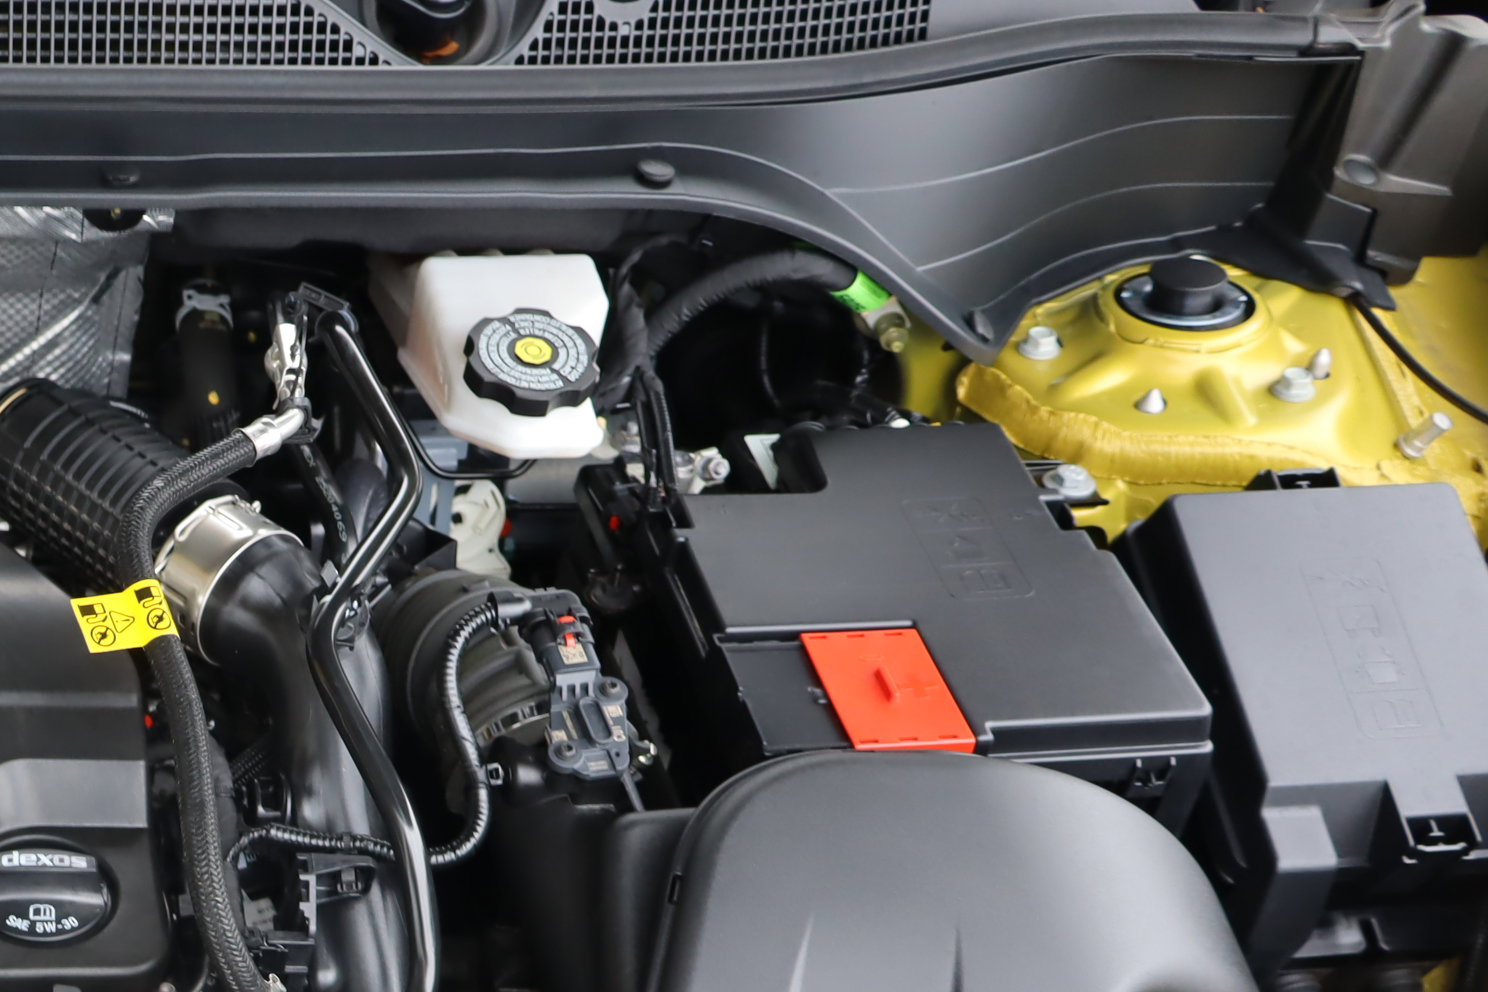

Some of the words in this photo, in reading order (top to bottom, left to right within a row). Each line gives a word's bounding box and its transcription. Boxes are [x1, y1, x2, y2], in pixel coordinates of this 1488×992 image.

[1, 850, 88, 869] dexos
[5, 914, 31, 932] SAE
[35, 915, 79, 934] 5W-30
